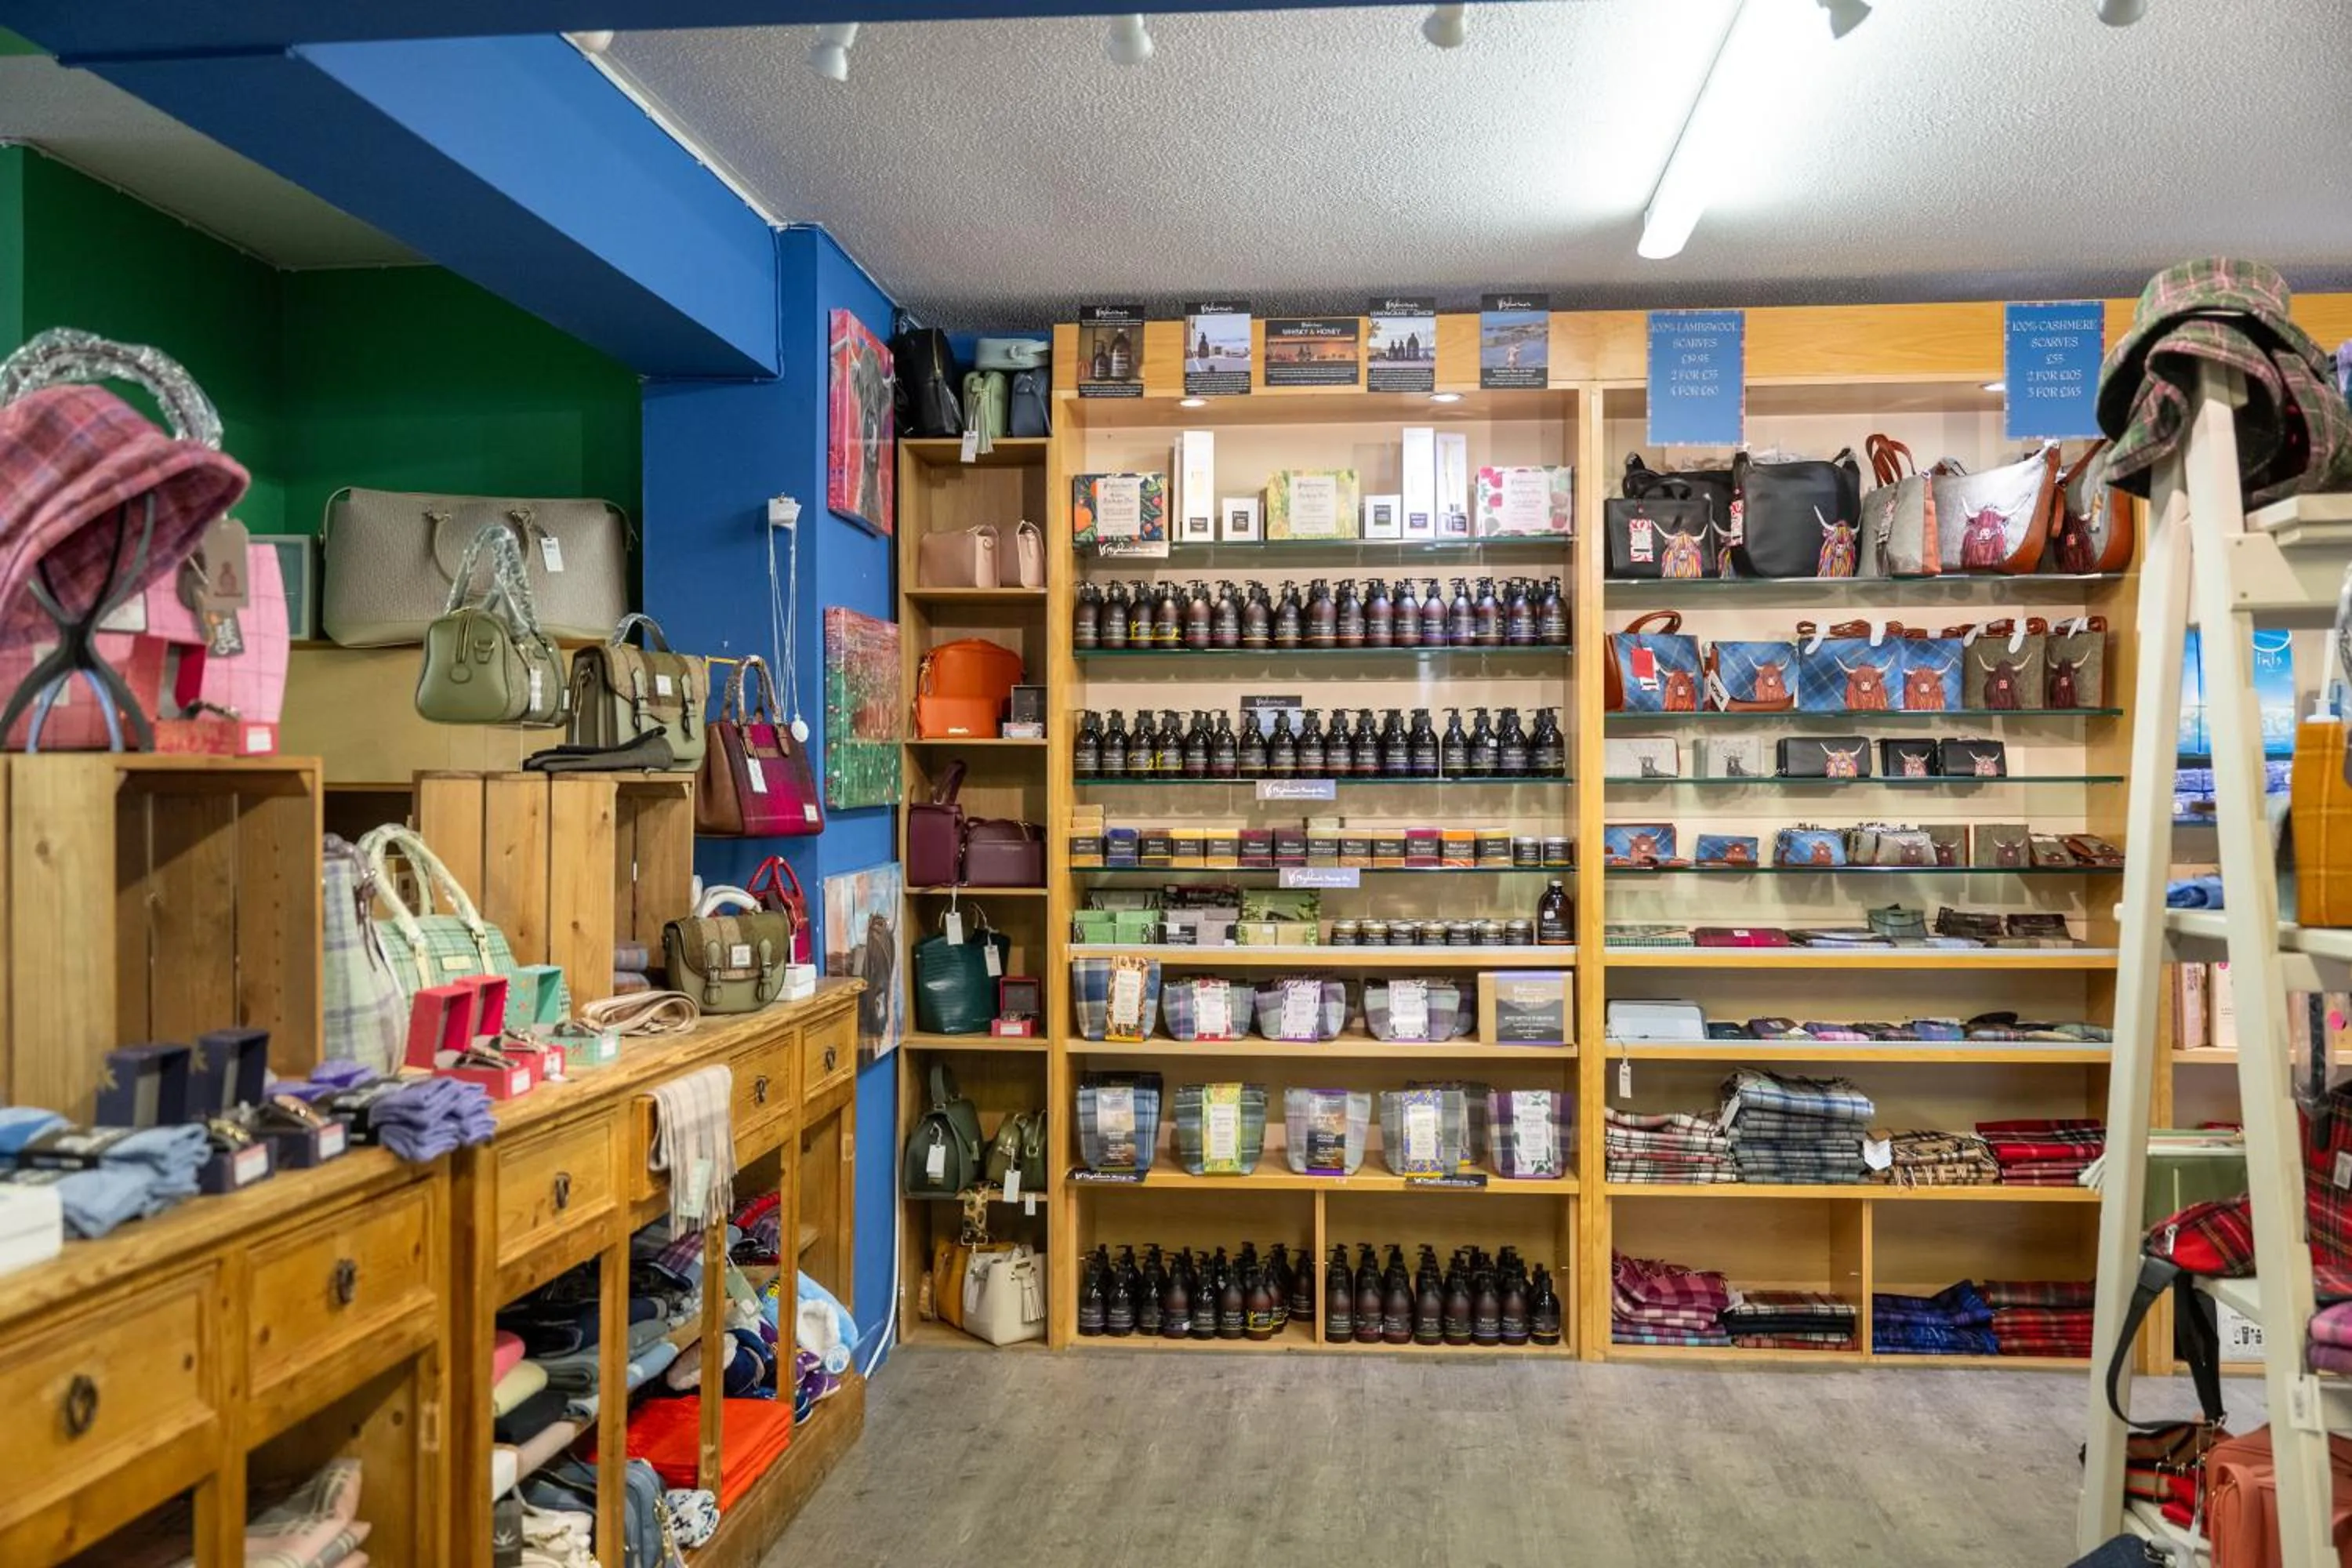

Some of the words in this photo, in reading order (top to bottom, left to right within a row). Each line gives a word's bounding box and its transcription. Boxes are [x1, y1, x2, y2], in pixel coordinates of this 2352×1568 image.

[1676, 320, 1737, 332] LAMBSWOOL
[2038, 318, 2098, 332] CASHMERE
[1672, 338, 1719, 349] SCARVES
[2031, 336, 2079, 349] SCARVES
[1670, 369, 1678, 381] 2
[1679, 369, 1700, 380] FOR
[2035, 369, 2059, 382] FOR
[1678, 385, 1700, 396] FOR
[2035, 386, 2059, 398] FOR
